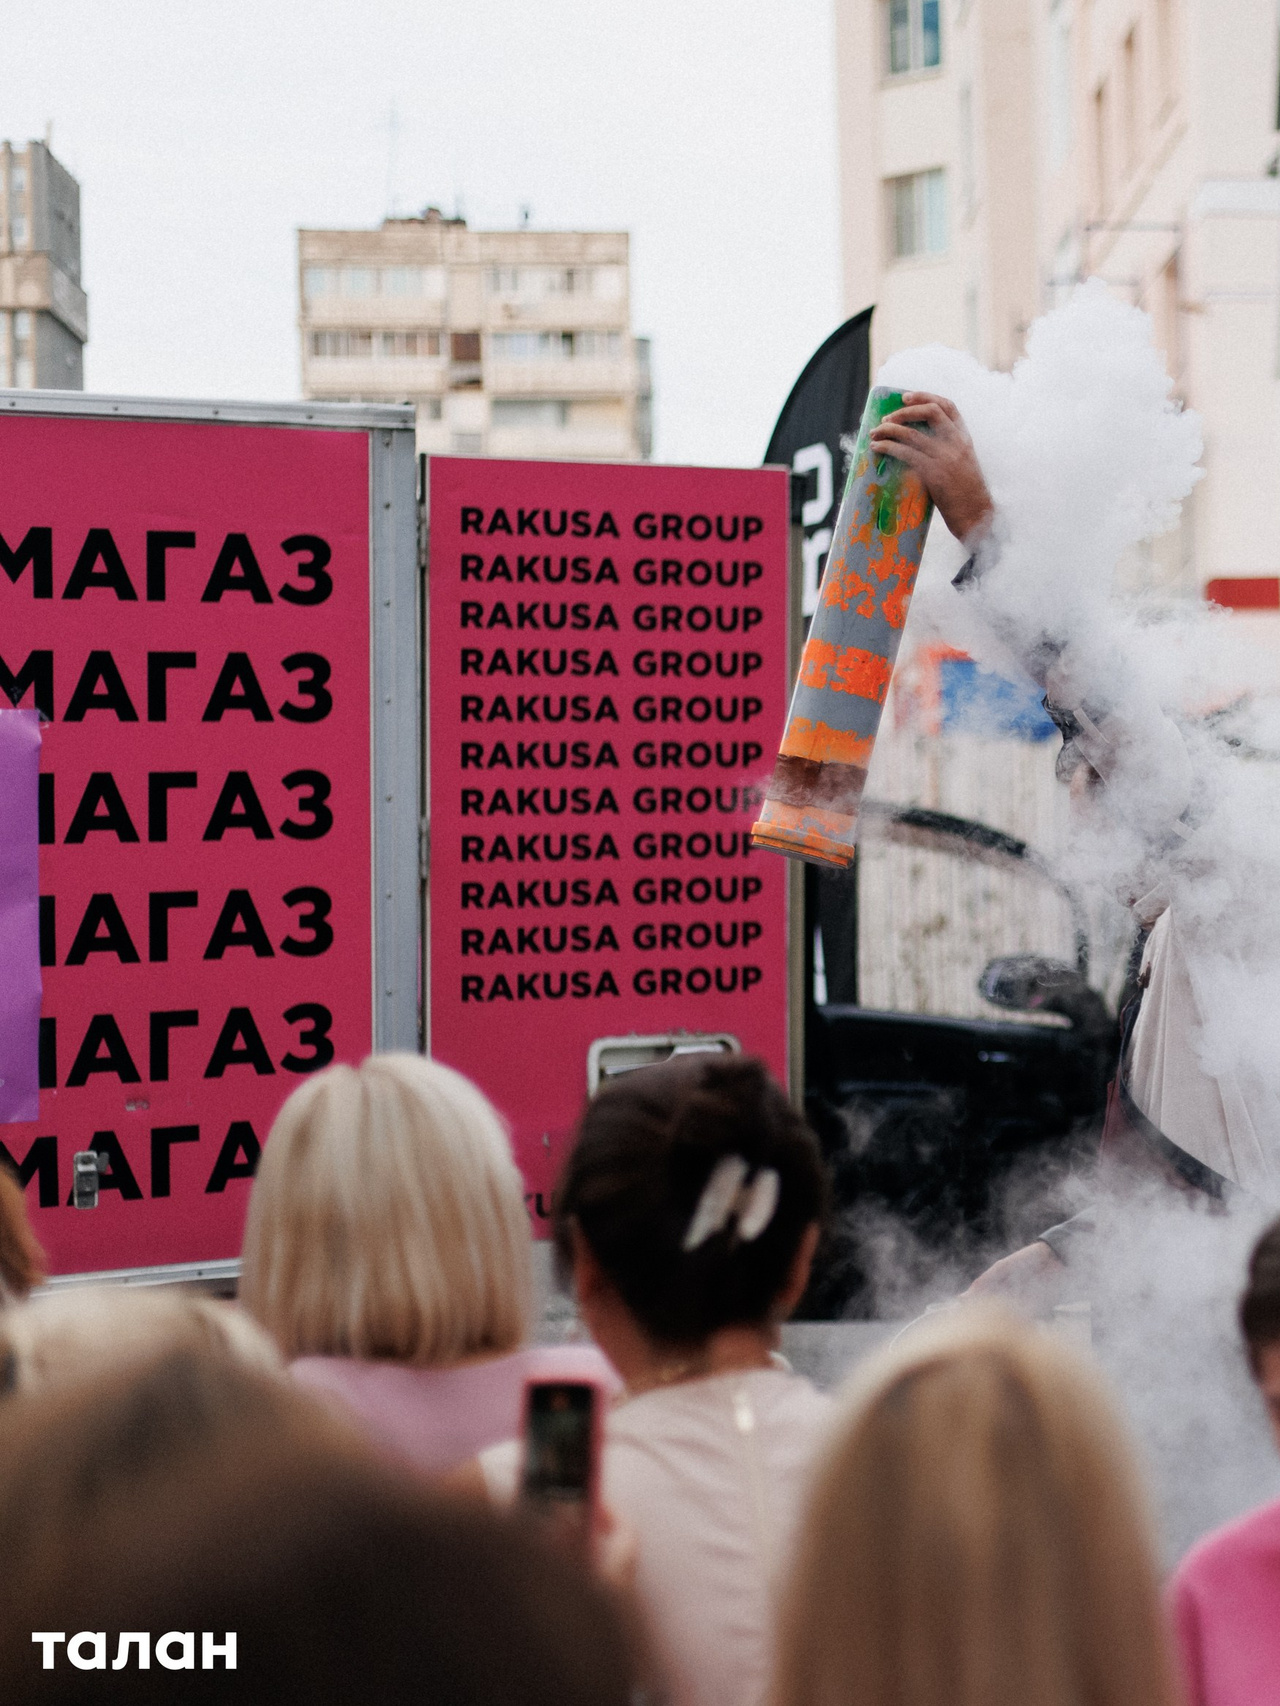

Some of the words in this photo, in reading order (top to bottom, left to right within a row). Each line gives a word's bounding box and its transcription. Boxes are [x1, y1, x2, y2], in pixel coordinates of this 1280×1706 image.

[461, 507, 620, 538] RAKUSA
[634, 513, 763, 542] GROUP
[461, 554, 619, 584] RAKUSA
[633, 558, 763, 587] GROUP
[461, 601, 619, 630] RAKUSA
[633, 604, 762, 632] GROUP
[461, 648, 619, 676] RAKUSA
[633, 650, 762, 678] GROUP
[461, 695, 619, 722] RAKUSA
[633, 696, 762, 723] GROUP
[461, 741, 619, 769] RAKUSA
[633, 741, 762, 769] GROUP
[38, 769, 333, 844] АГАЗ
[461, 788, 619, 816] RAKUSA
[633, 787, 762, 814] GROUP
[461, 833, 619, 863] RAKUSA
[461, 879, 619, 909] RAKUSA
[633, 877, 762, 905] GROUP
[39, 886, 334, 967] АГАЗ
[461, 925, 619, 956] RAKUSA
[633, 921, 762, 950] GROUP
[461, 970, 620, 1003] RAKUSA
[633, 966, 762, 996] GROUP
[39, 1003, 334, 1089] АГАЗ
